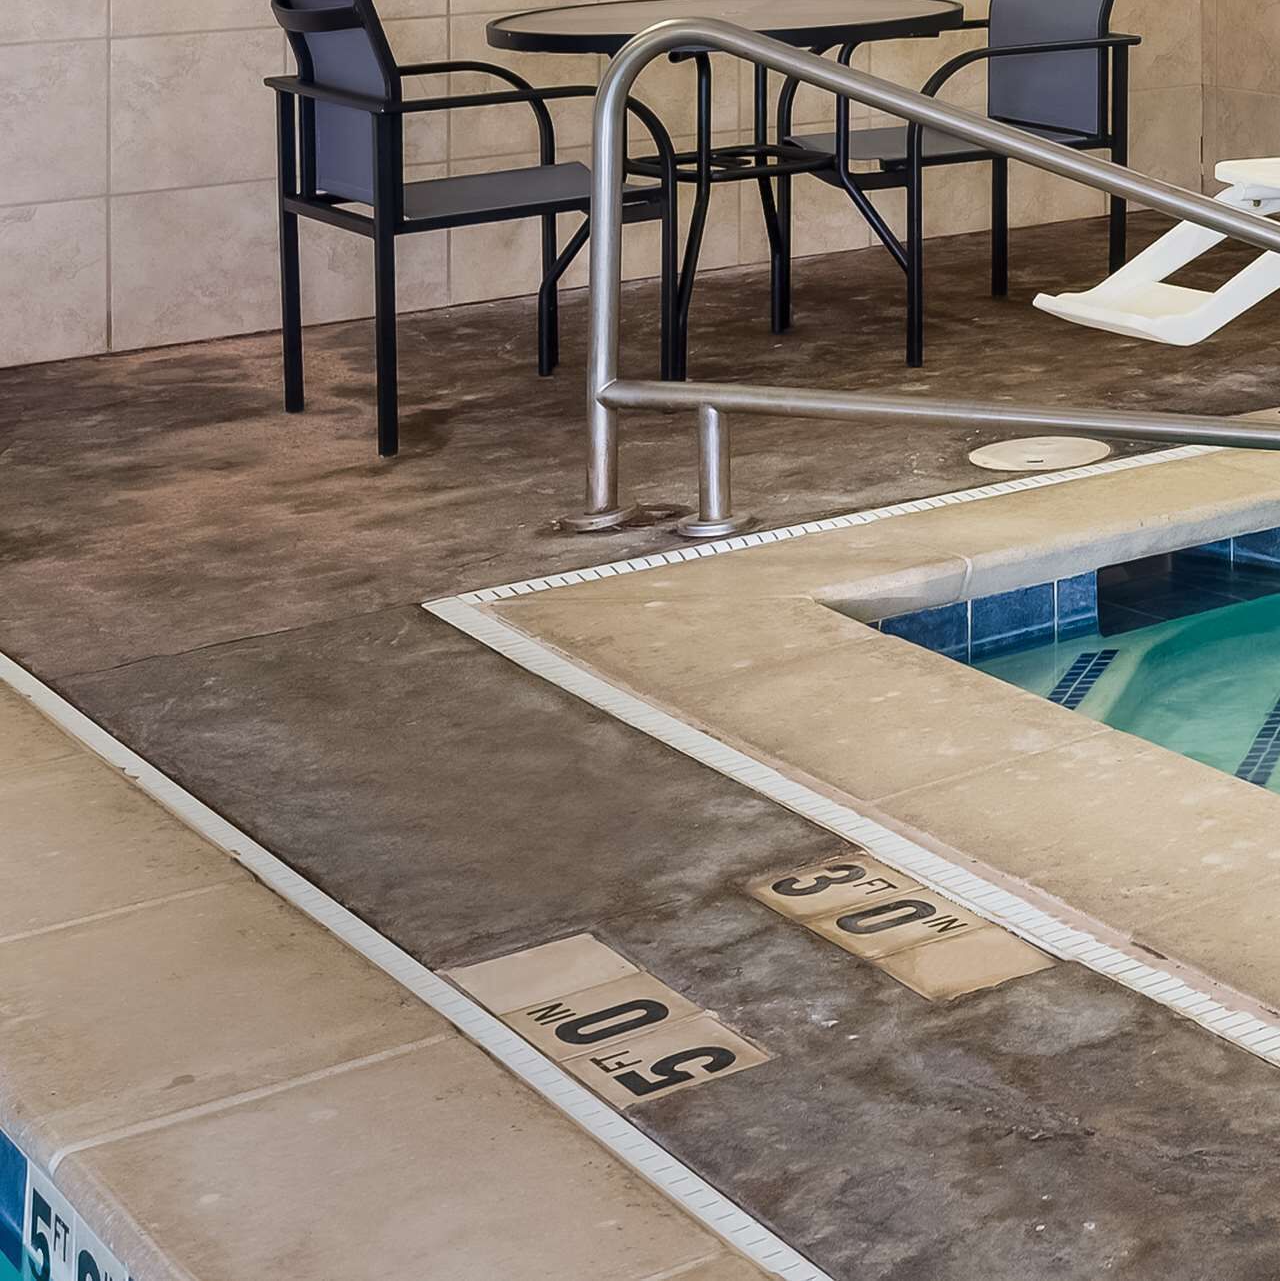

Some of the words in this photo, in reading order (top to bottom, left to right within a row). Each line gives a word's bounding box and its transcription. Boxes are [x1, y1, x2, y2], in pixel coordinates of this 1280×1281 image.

[771, 864, 866, 896] 3
[853, 877, 898, 896] FT
[836, 899, 937, 935] 0
[923, 914, 968, 935] IN
[526, 1002, 576, 1026] IN
[555, 999, 669, 1045] 0
[590, 1050, 642, 1074] FT
[613, 1046, 737, 1097] 5
[28, 1187, 51, 1281] 5
[54, 1214, 69, 1262] FT
